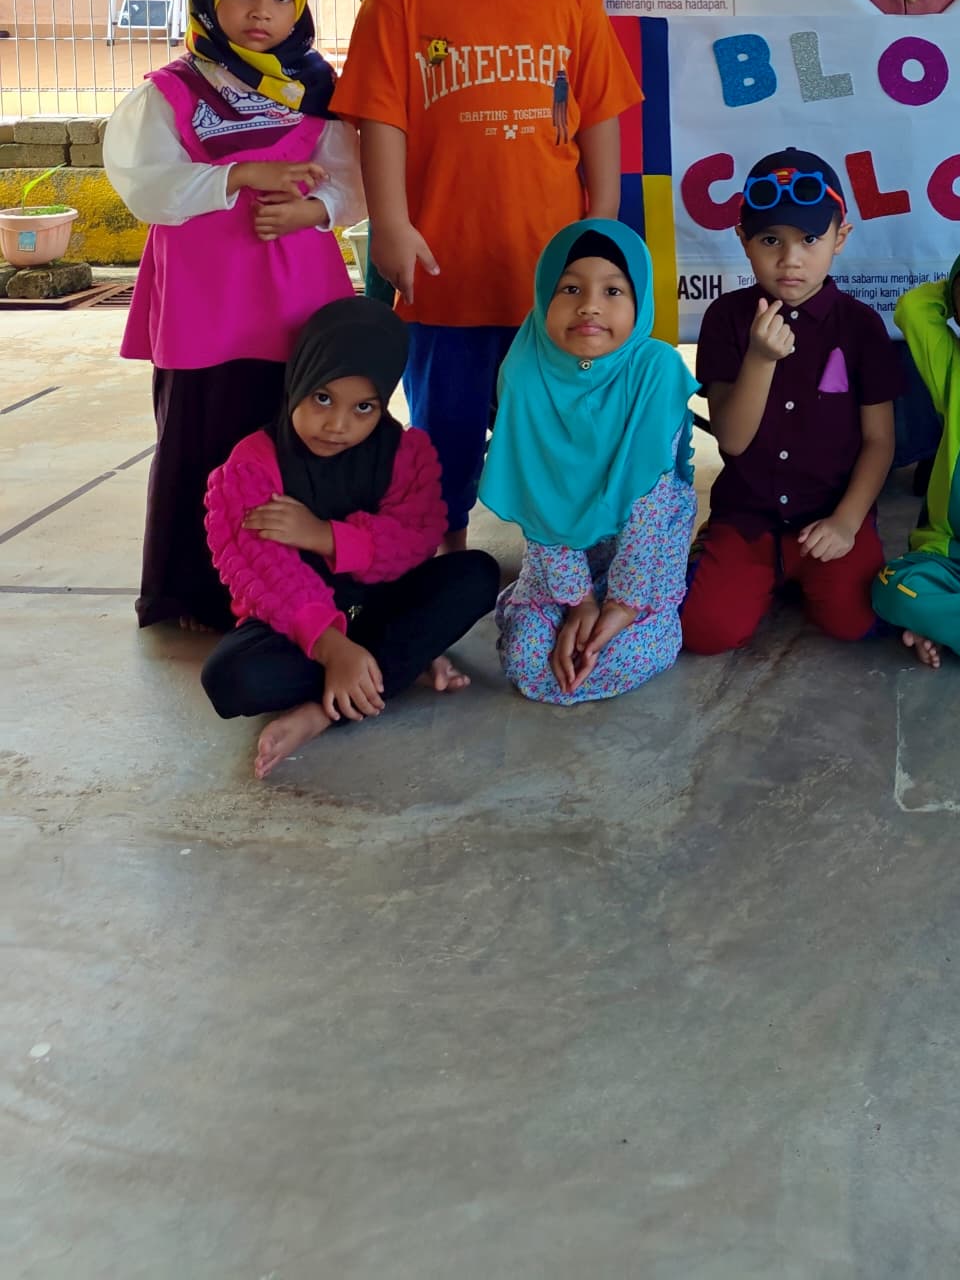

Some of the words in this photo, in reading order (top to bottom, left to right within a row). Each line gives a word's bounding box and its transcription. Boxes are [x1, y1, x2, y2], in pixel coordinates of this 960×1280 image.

[657, 0, 683, 10] masa
[460, 110, 508, 122] CRAFTING
[851, 272, 888, 284] sabarmu
[677, 275, 722, 300] ASIH
[880, 287, 900, 298] kami
